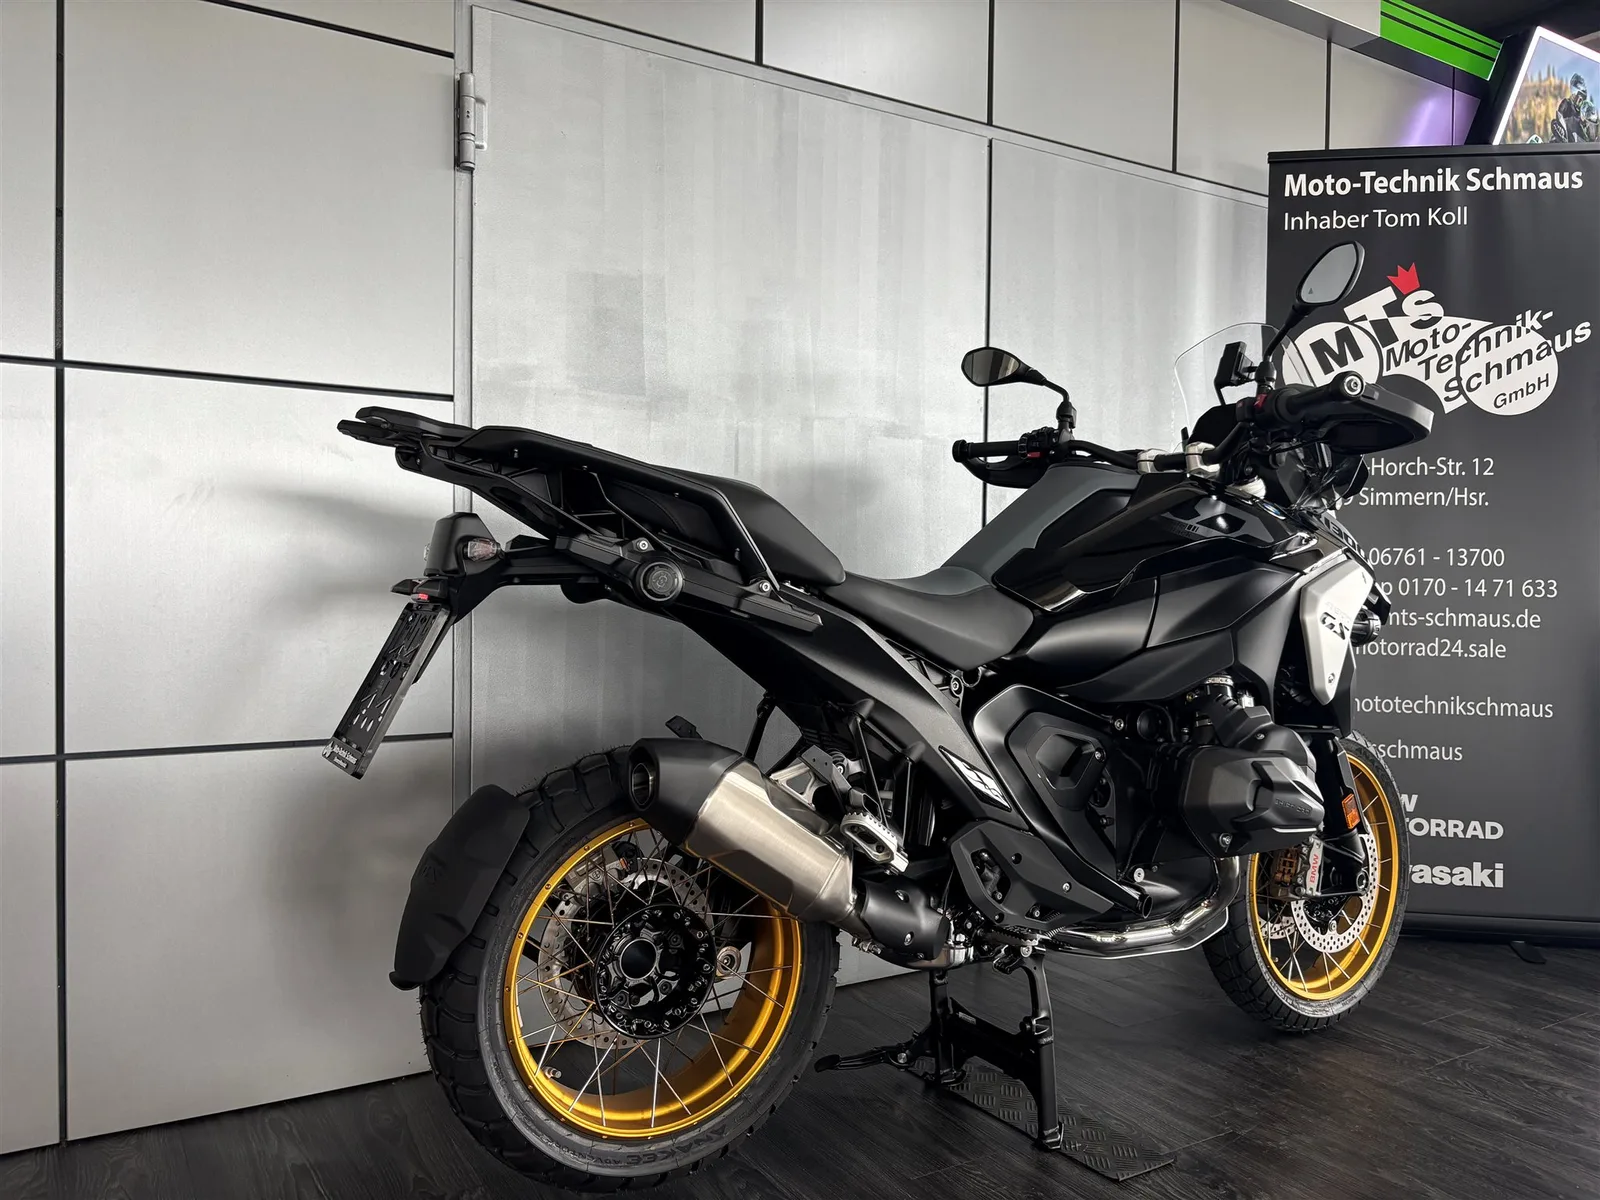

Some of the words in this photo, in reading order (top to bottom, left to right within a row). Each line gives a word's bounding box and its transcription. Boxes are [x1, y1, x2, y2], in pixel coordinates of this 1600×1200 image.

[1283, 167, 1461, 197] Moto-Technik
[1466, 166, 1584, 192] Schmaus
[1284, 209, 1369, 231] Inhaber
[1372, 208, 1420, 228] Tom
[1428, 206, 1468, 226] Koll
[1385, 321, 1473, 372] Moto-
[1417, 309, 1554, 381] Technik-
[1443, 321, 1592, 402] Schmaus
[1493, 373, 1550, 409] GmbH
[1472, 457, 1495, 476] 12
[1359, 486, 1489, 507] Simmern/Hsr.
[1368, 547, 1426, 567] 06761
[1446, 548, 1506, 567] 13700
[1398, 577, 1447, 597] 0170
[1464, 578, 1488, 597] 14
[1492, 579, 1513, 598] 71
[1521, 579, 1559, 598] 633
[1372, 739, 1463, 761] schmaus
[1405, 817, 1504, 840] ORRAD
[1309, 853, 1320, 884] BMW
[1409, 861, 1504, 888] asaki
